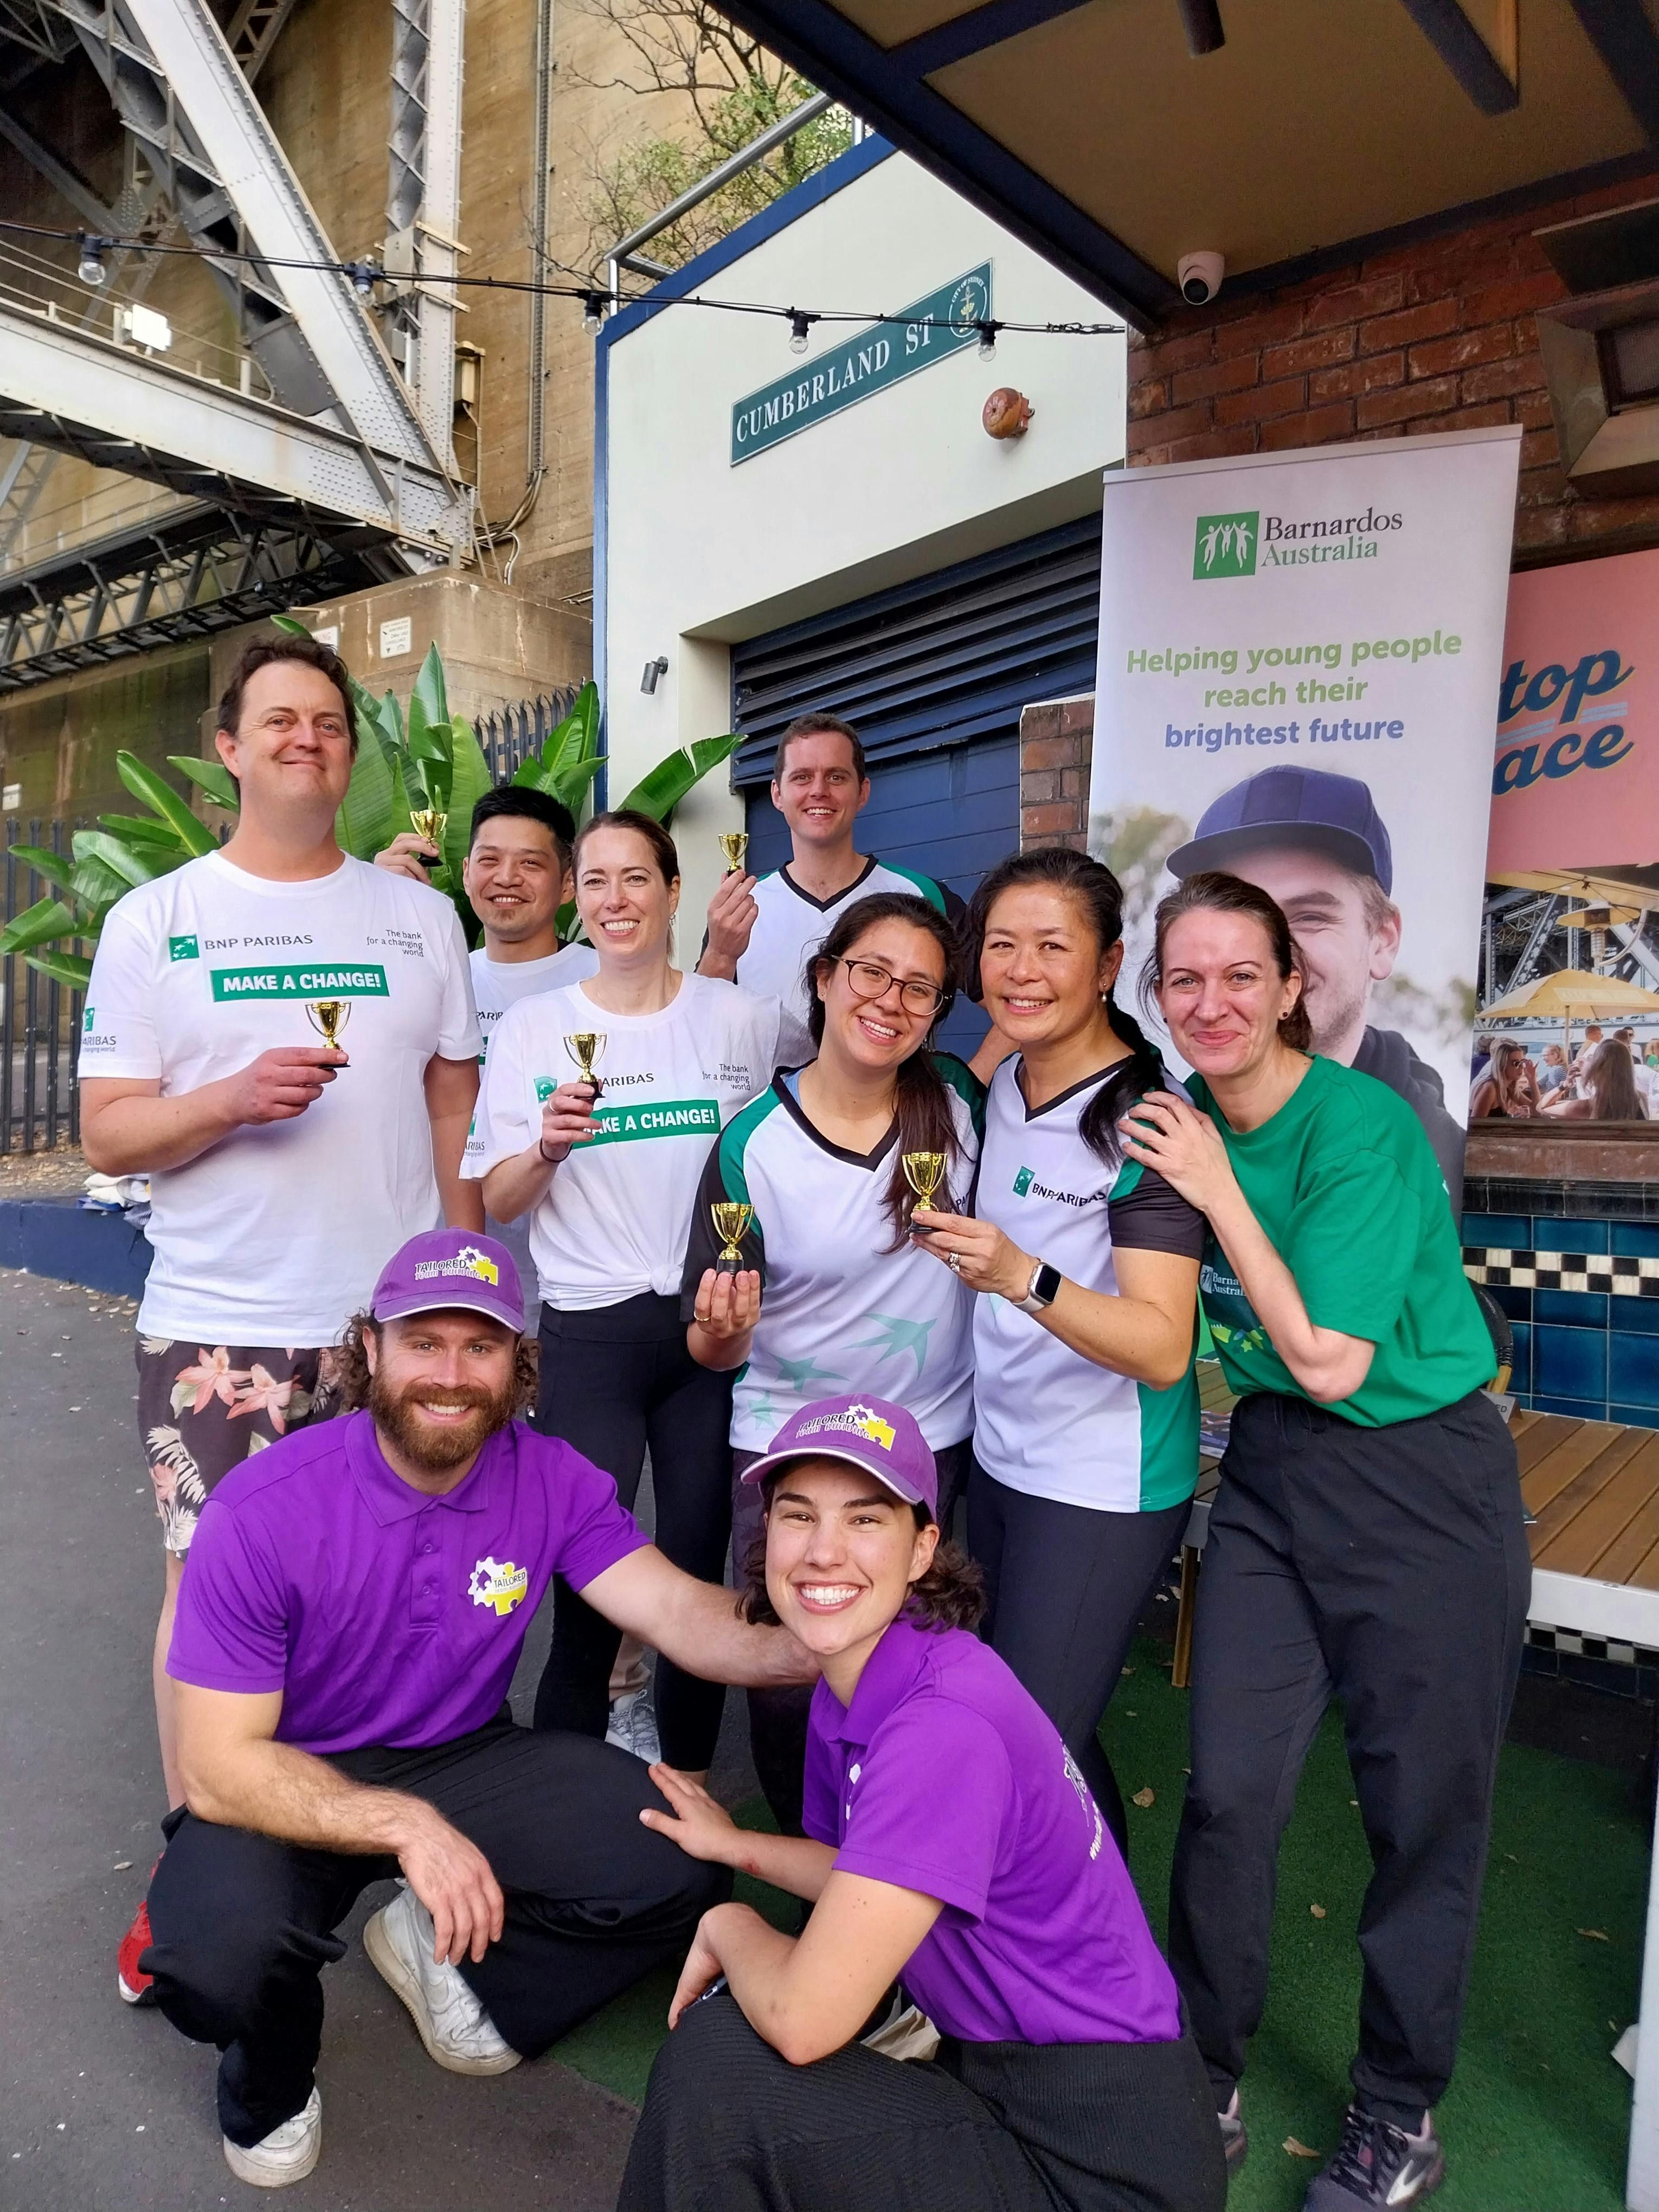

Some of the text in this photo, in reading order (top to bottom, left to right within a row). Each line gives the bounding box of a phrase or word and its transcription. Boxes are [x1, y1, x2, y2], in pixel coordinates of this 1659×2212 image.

[736, 313, 934, 442] CUMBERLAND ST
[1264, 507, 1403, 542] Barnardos
[1261, 536, 1378, 567] Australia
[1127, 630, 1462, 677] Helping young people
[1204, 677, 1368, 708] reach their
[1497, 650, 1635, 725] top
[1165, 718, 1405, 753] brightest future
[204, 935, 313, 949] BNP PARIBAS
[366, 936, 378, 945] for
[388, 938, 423, 950] changing
[402, 931, 422, 939] bank
[402, 949, 424, 957] world
[223, 972, 381, 992] MAKE A CHANGE!
[719, 1063, 749, 1073] The bank
[702, 1071, 711, 1079] for
[720, 1073, 749, 1084] changing
[583, 1109, 715, 1135] KE A CHANGE!
[1032, 1183, 1054, 1199] BNP
[416, 1259, 466, 1273] TAILORED
[1213, 1272, 1241, 1286] Barna
[1212, 1283, 1246, 1296] Austral
[799, 1414, 855, 1431] TAILORED
[494, 1572, 525, 1587] TAILORED
